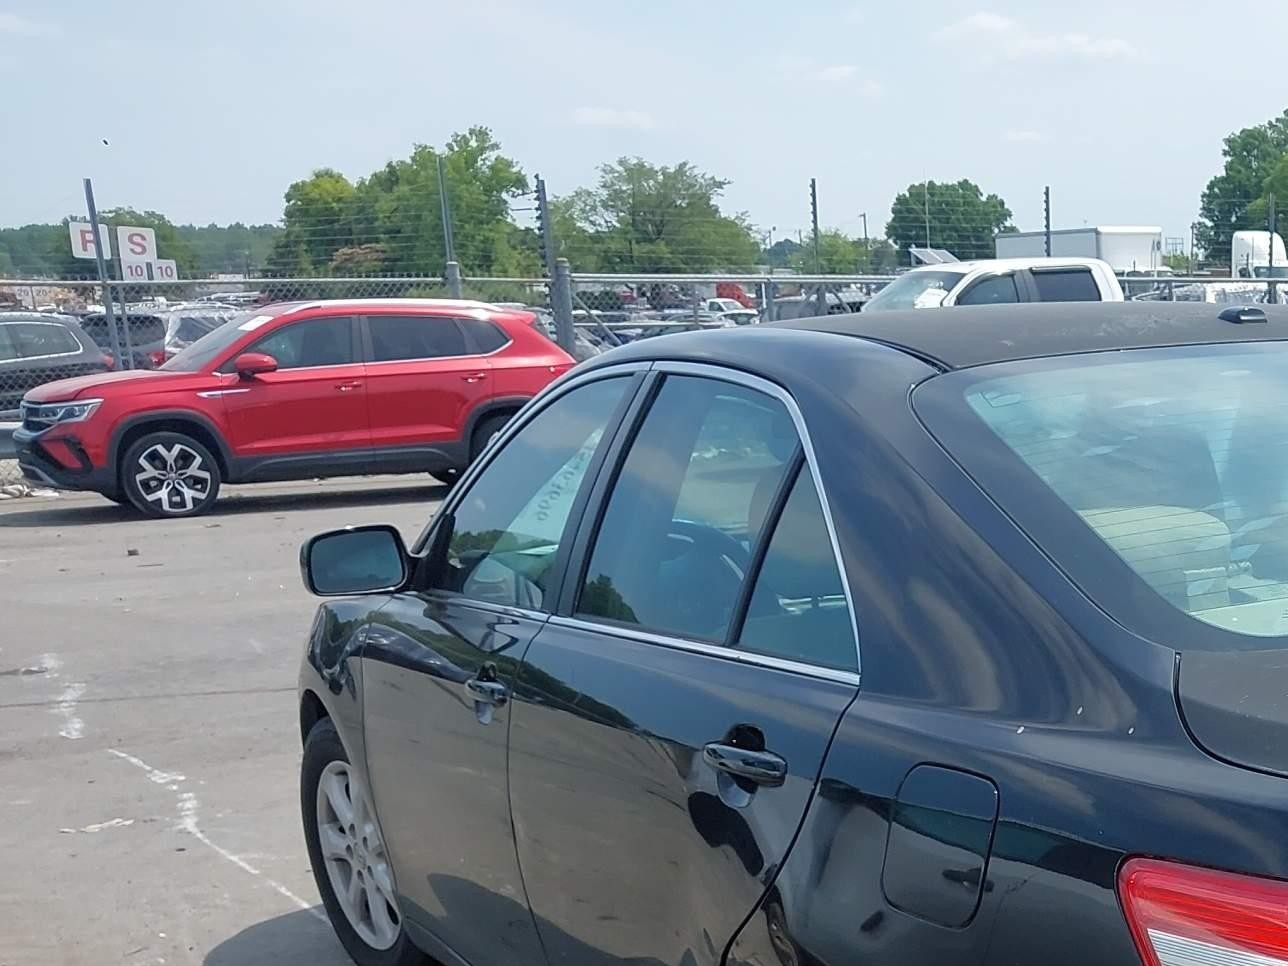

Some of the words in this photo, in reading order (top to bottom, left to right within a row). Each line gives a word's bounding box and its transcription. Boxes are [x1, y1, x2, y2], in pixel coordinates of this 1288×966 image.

[128, 233, 147, 255] S
[128, 265, 143, 277] 10
[157, 266, 173, 278] 10
